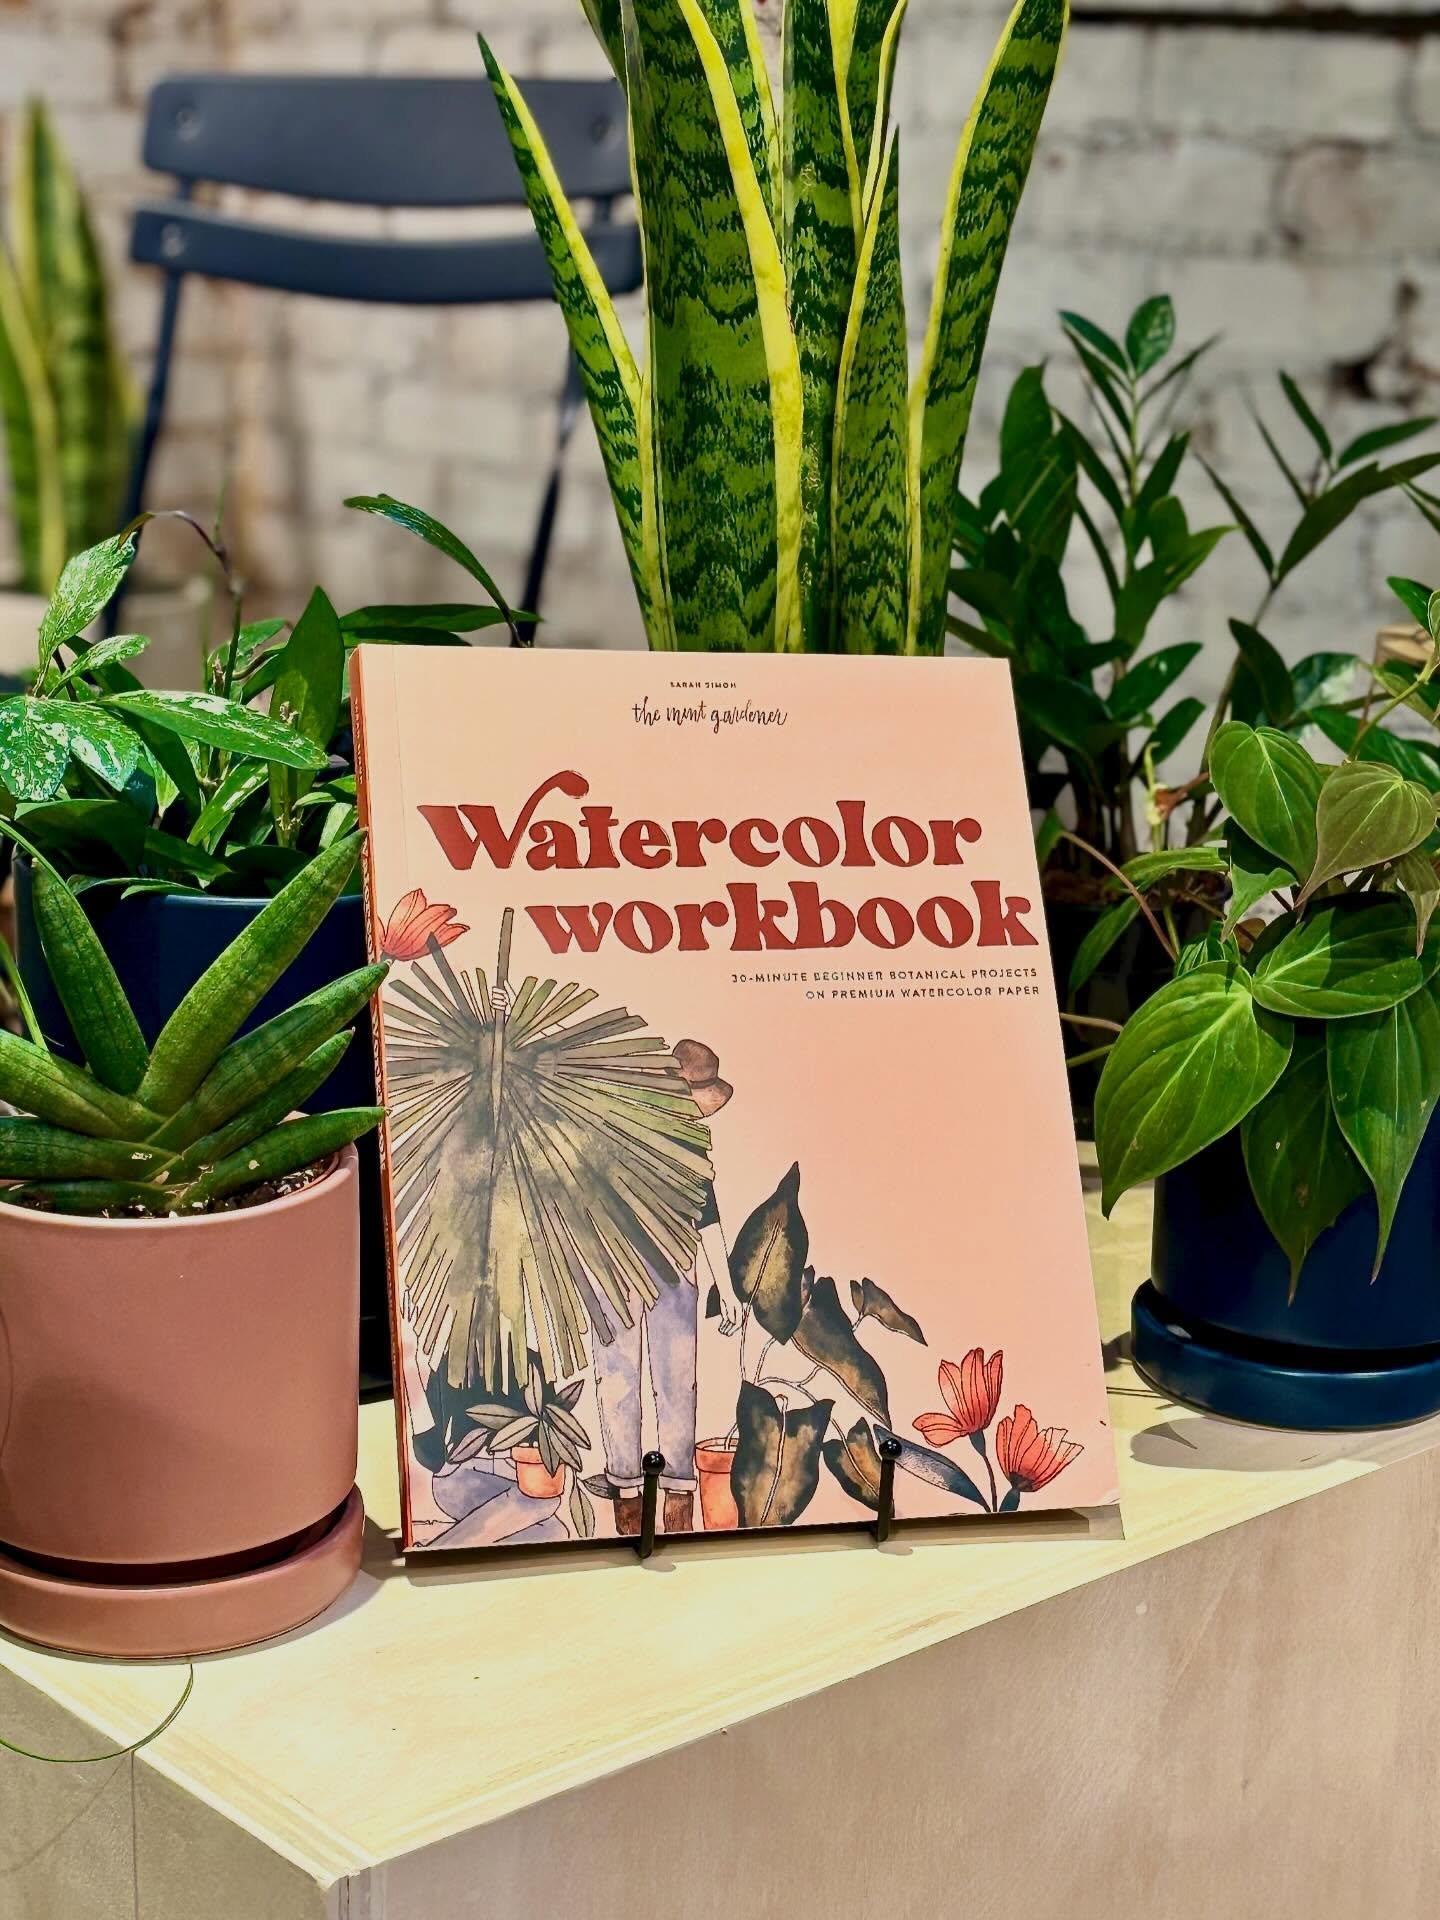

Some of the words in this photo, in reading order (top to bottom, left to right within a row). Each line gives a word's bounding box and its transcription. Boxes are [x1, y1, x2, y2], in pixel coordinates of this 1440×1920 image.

[670, 681, 701, 689] SARAH
[704, 681, 737, 689] SIMON
[631, 695, 661, 726] the
[666, 700, 707, 726] mint
[710, 698, 788, 734] gardener
[417, 769, 982, 870] Watercolor
[524, 880, 1039, 954] workbook
[731, 972, 808, 983] 30-MINUTE
[813, 970, 884, 982] BEGINNER
[889, 969, 966, 981] BOTANICAL
[971, 967, 1038, 979] PROJECTS
[805, 989, 825, 1000] ON
[831, 988, 895, 999] PREMIUM
[900, 986, 992, 998] WATERCOLOR
[998, 985, 1040, 996] PAPER
